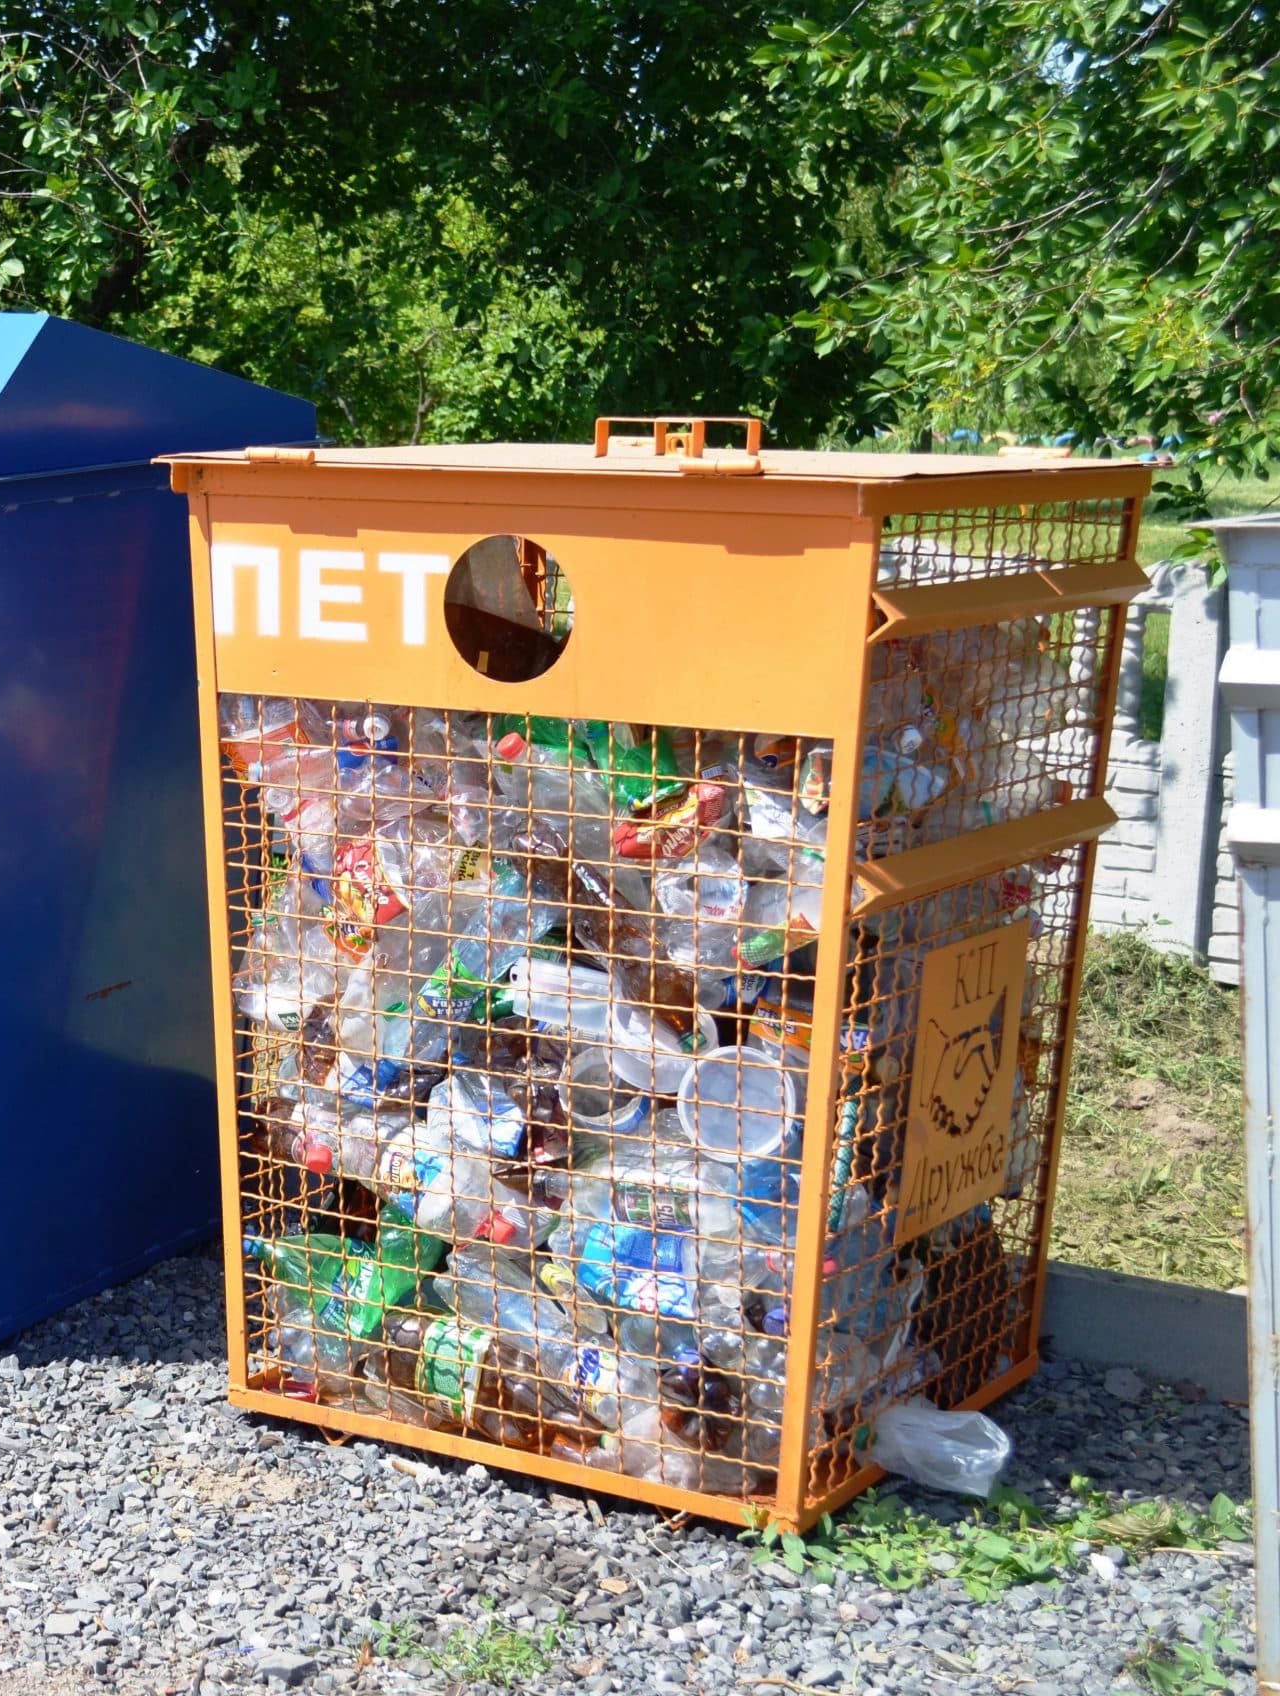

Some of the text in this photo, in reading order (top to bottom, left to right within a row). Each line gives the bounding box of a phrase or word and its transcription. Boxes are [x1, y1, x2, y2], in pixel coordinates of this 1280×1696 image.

[211, 543, 450, 646] ПЕТ
[952, 941, 1000, 1009] КП
[902, 1123, 1004, 1233] Дружба
